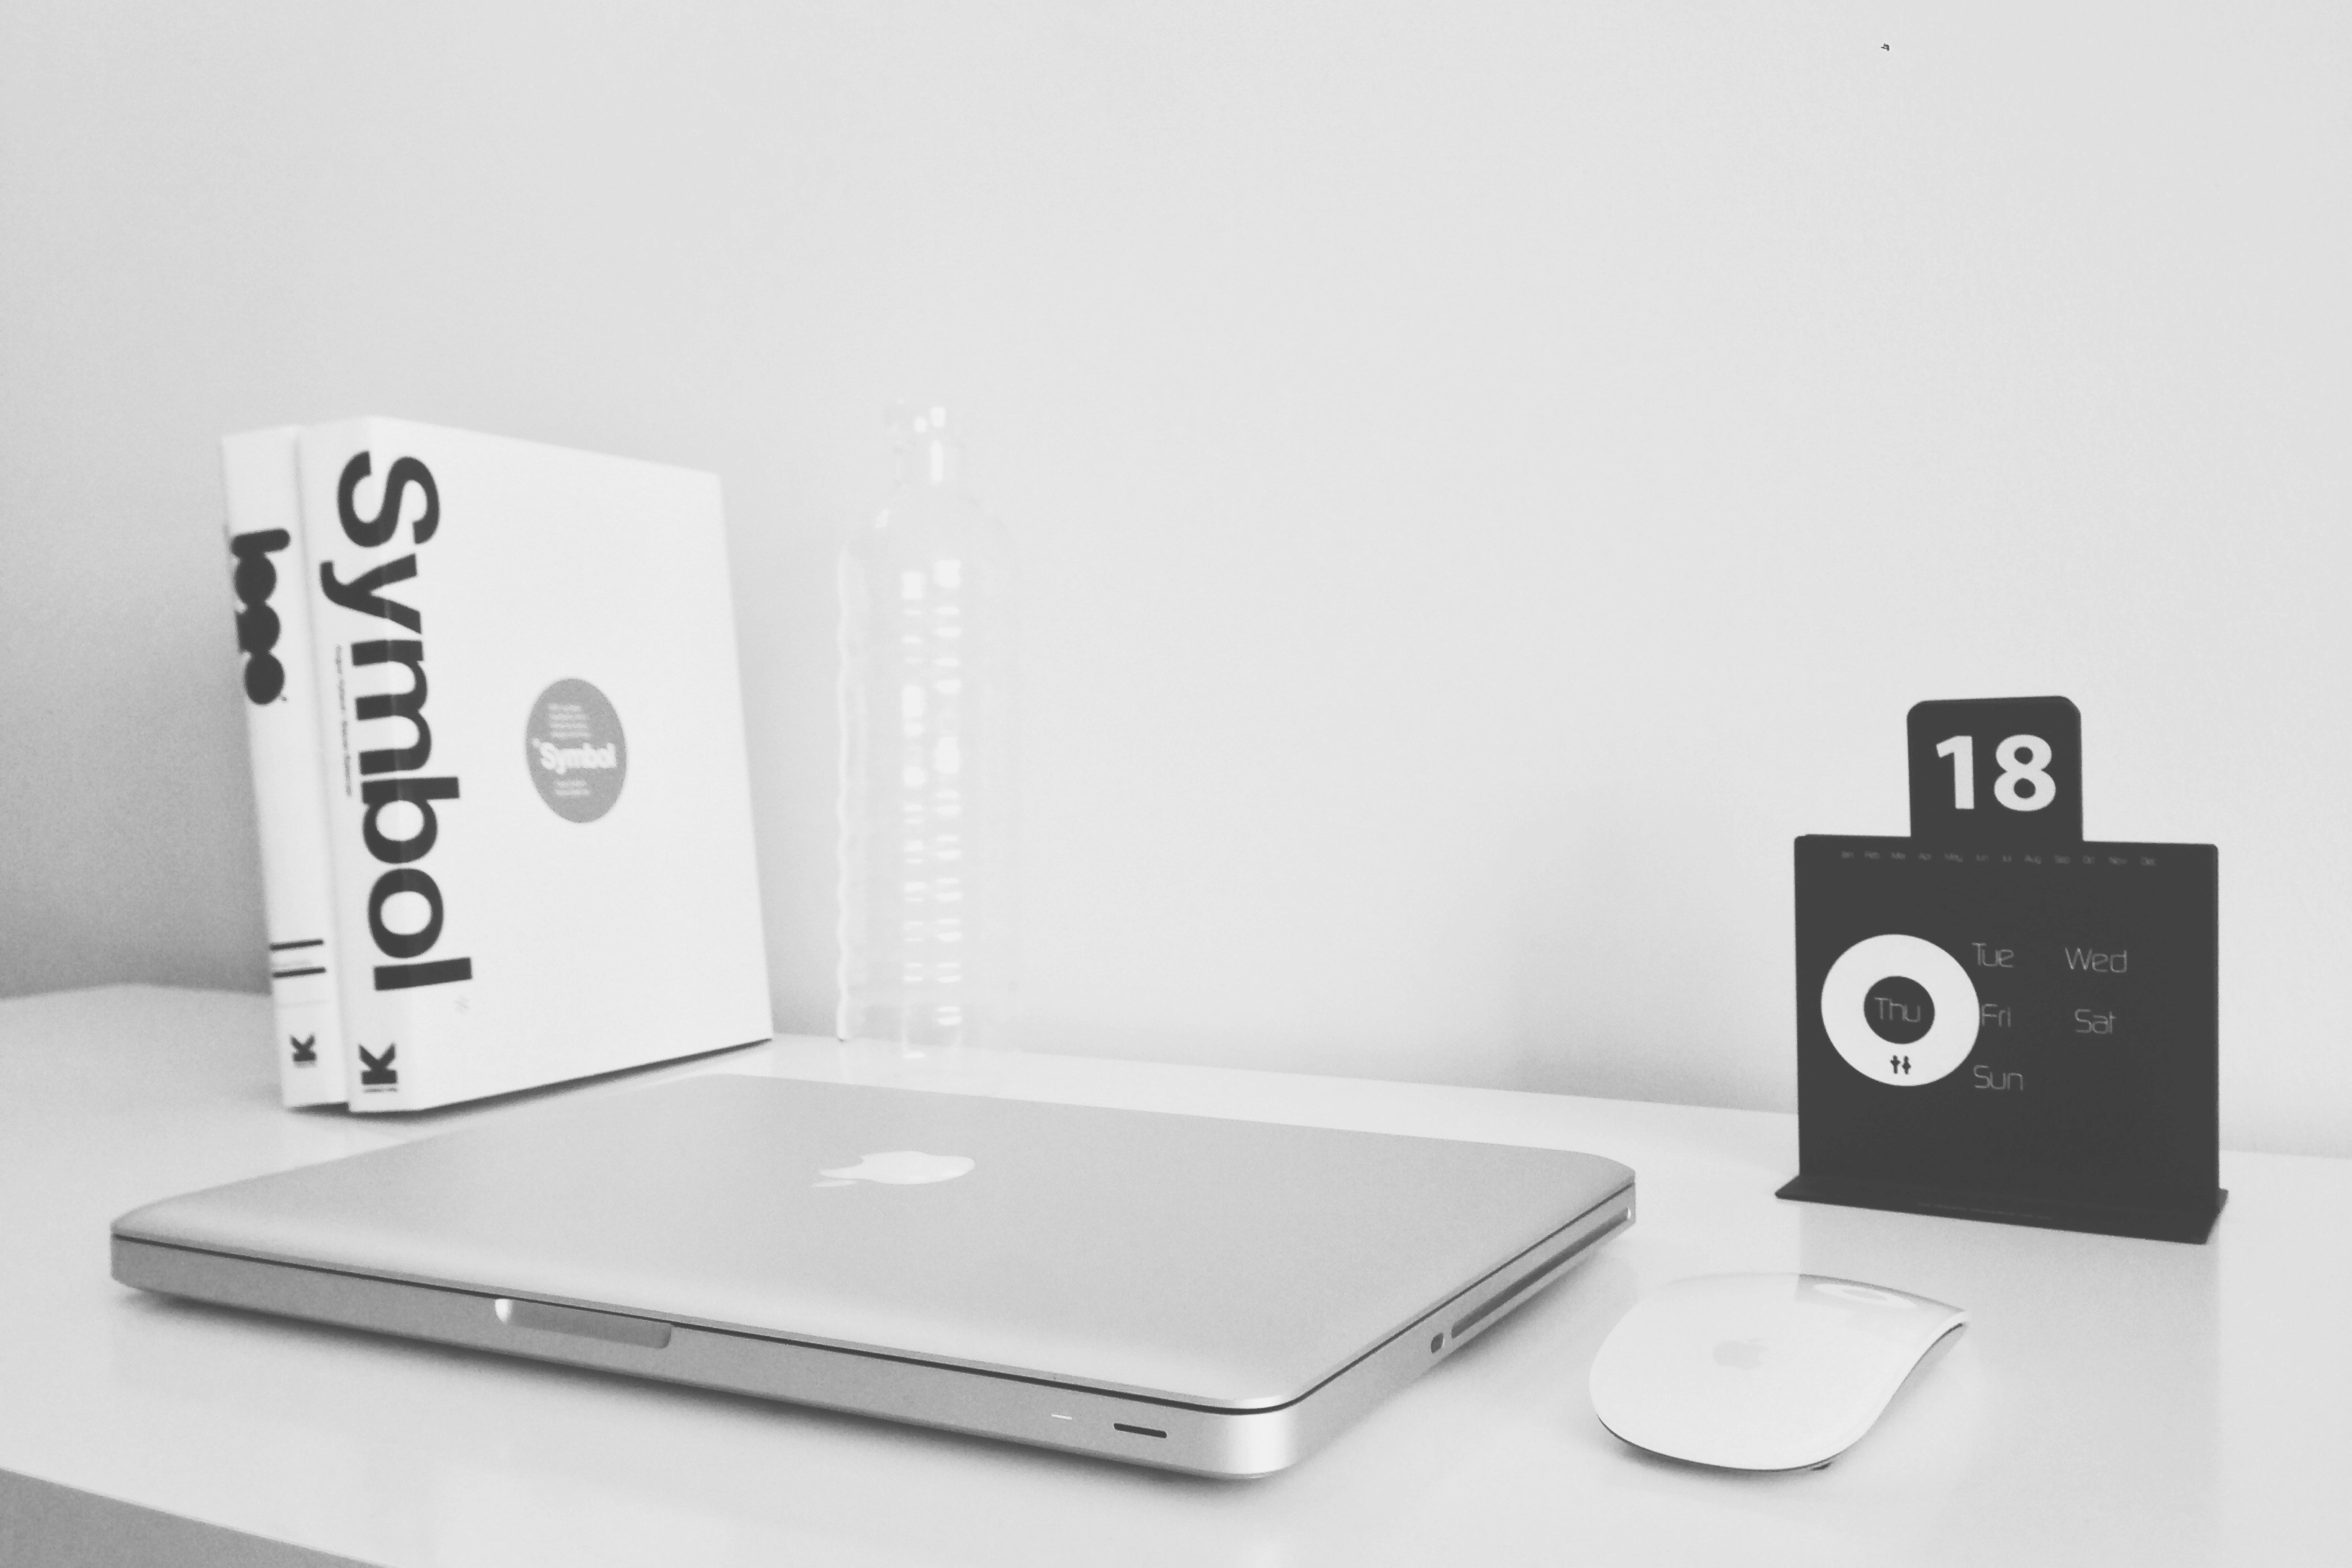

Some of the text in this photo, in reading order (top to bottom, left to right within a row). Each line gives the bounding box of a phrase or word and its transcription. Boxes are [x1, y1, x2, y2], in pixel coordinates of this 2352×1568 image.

[319, 450, 472, 992] Symbol
[1936, 734, 2057, 811] 18
[1972, 942, 2128, 974] Tue Wed
[1874, 997, 2117, 1035] Thu Fri Sat
[1973, 1064, 2023, 1091] Sun
